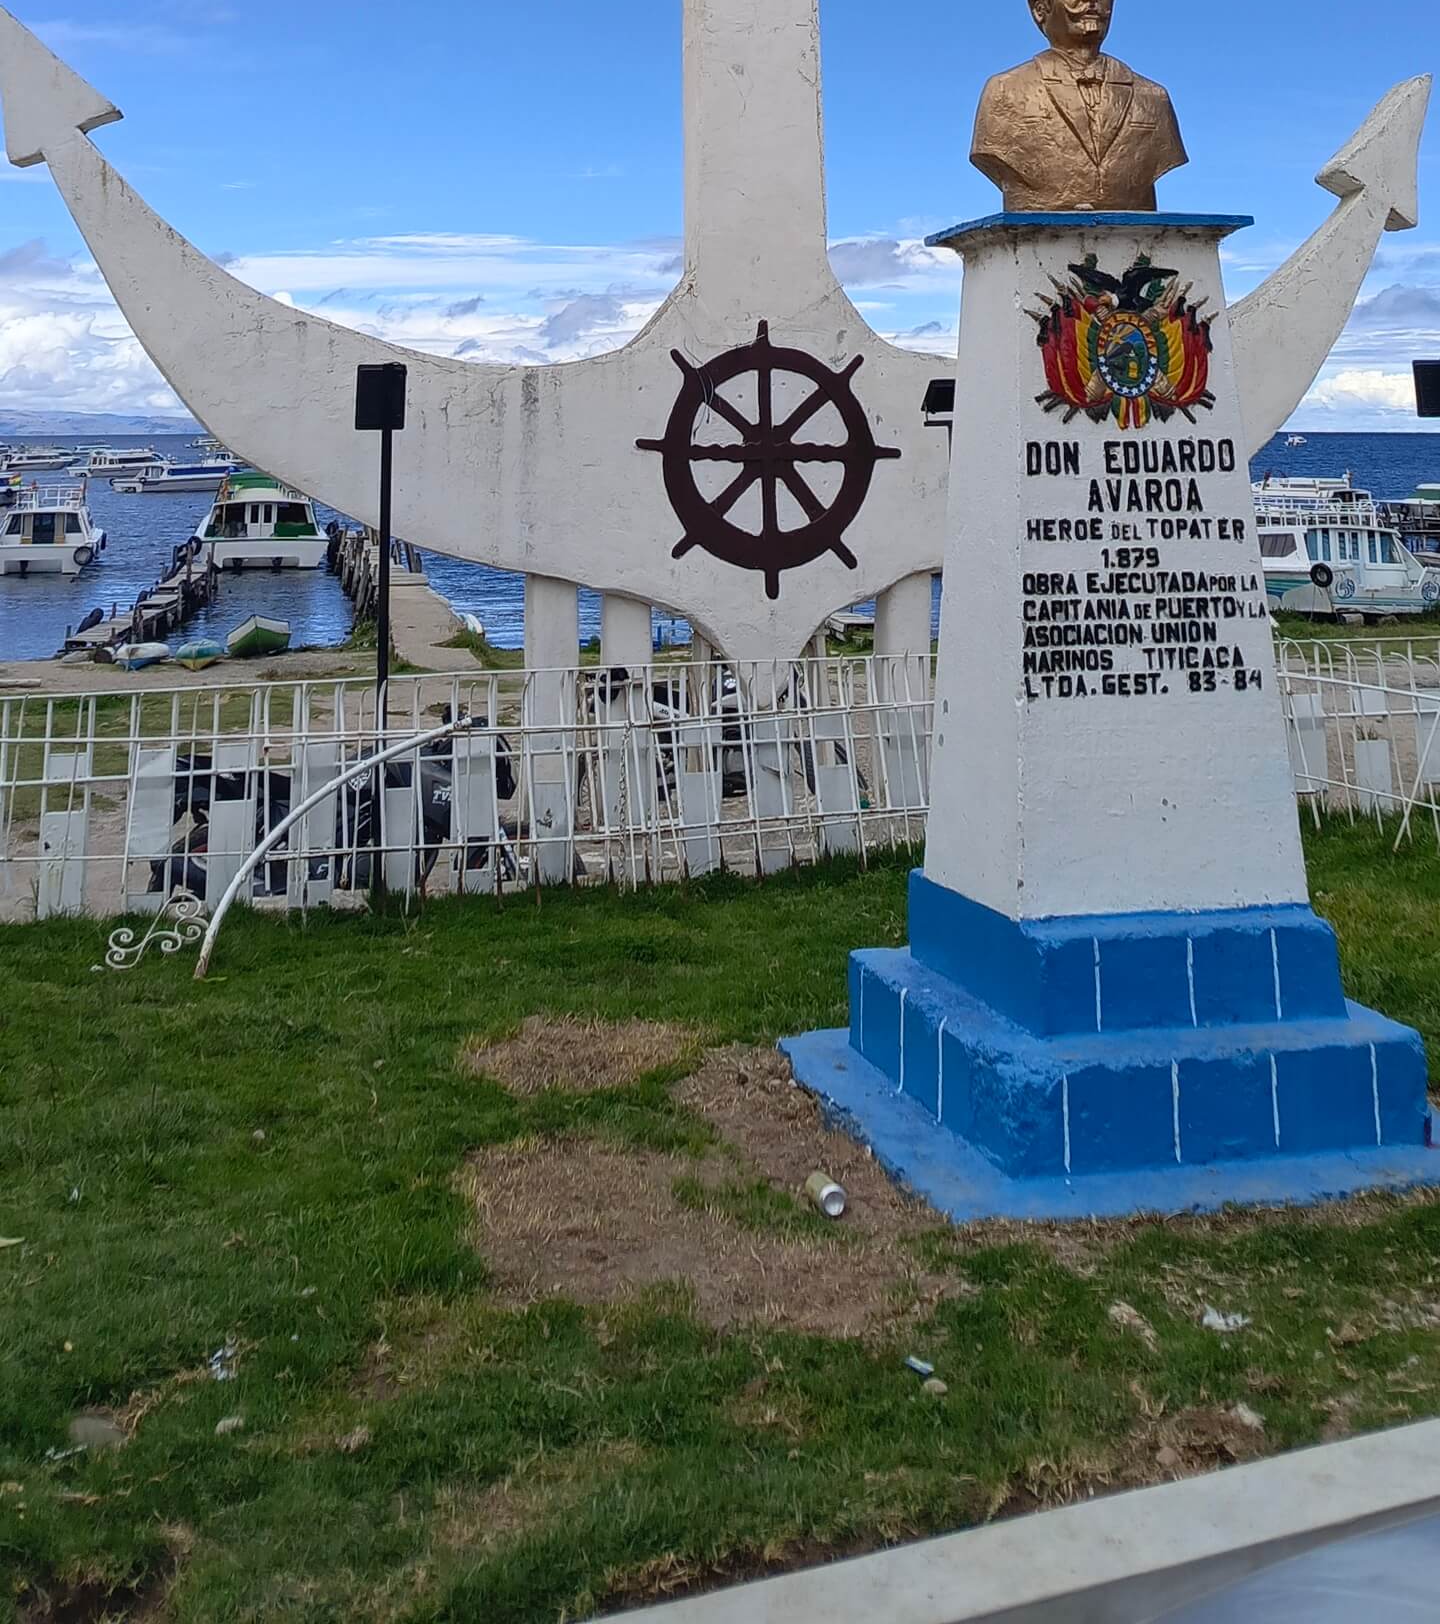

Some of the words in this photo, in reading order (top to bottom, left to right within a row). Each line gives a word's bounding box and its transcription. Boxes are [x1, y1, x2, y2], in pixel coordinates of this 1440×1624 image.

[1026, 441, 1080, 475] DON
[1104, 439, 1236, 474] EDUARDO
[1088, 478, 1203, 512] AVAROA
[1026, 518, 1103, 541] HEROE
[1111, 524, 1142, 540] DEL
[1146, 518, 1245, 540] TOPATER
[1101, 547, 1160, 568] 1.879
[1023, 573, 1079, 595] OBRA
[1086, 571, 1210, 594] EJECUTADA
[1209, 575, 1236, 592] POR
[1241, 575, 1258, 592] LA
[1023, 599, 1130, 621] CAPITANIA
[1134, 603, 1151, 619] DE
[1155, 597, 1236, 619] PUERTO
[1236, 600, 1245, 618] Y
[1248, 601, 1266, 618] LA
[1023, 623, 1143, 647] ASOCIACION
[1151, 620, 1217, 644] UNION
[1023, 649, 1113, 674] MARINOS
[1142, 646, 1244, 670] TITICACA
